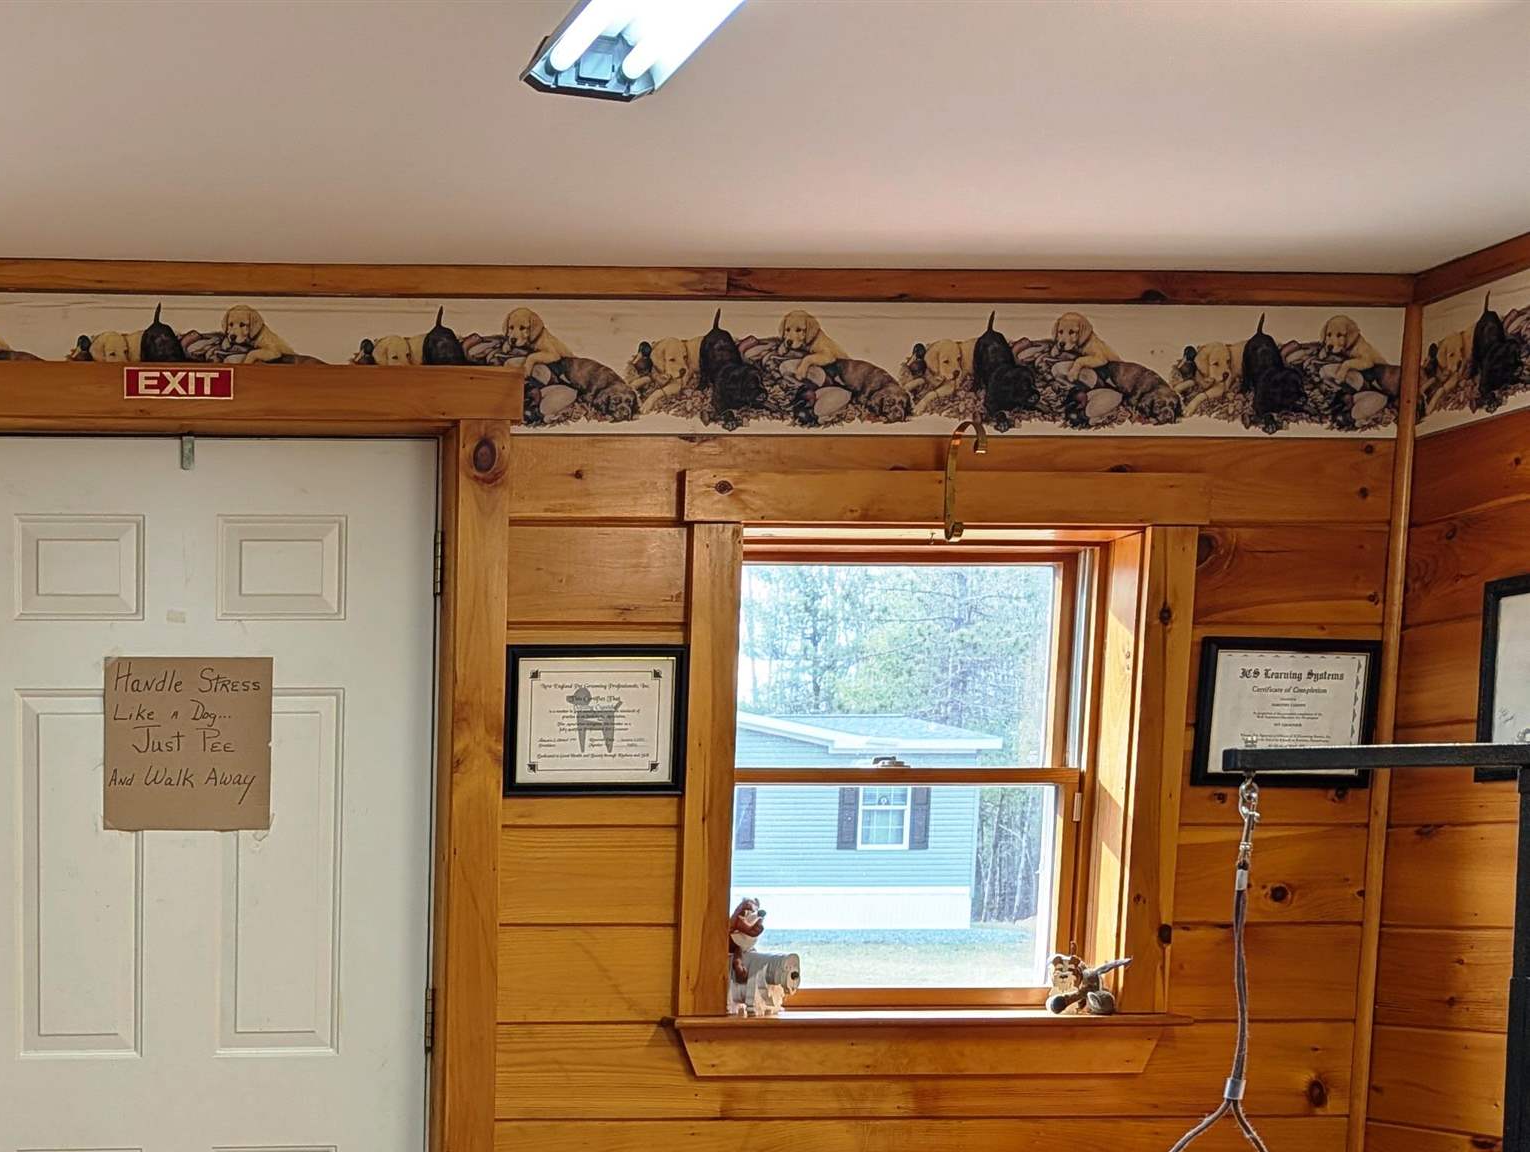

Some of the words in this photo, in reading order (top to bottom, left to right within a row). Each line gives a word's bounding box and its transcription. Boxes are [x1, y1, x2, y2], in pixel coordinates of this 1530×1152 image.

[138, 371, 219, 395] EXIT
[1264, 668, 1303, 681] Learning
[1306, 669, 1345, 682] Systems
[1252, 685, 1283, 693] Certificate
[1293, 686, 1327, 695] Completion
[113, 703, 155, 721] Like
[132, 724, 186, 754] Just
[144, 765, 195, 788] Walk
[205, 767, 256, 805] Away
